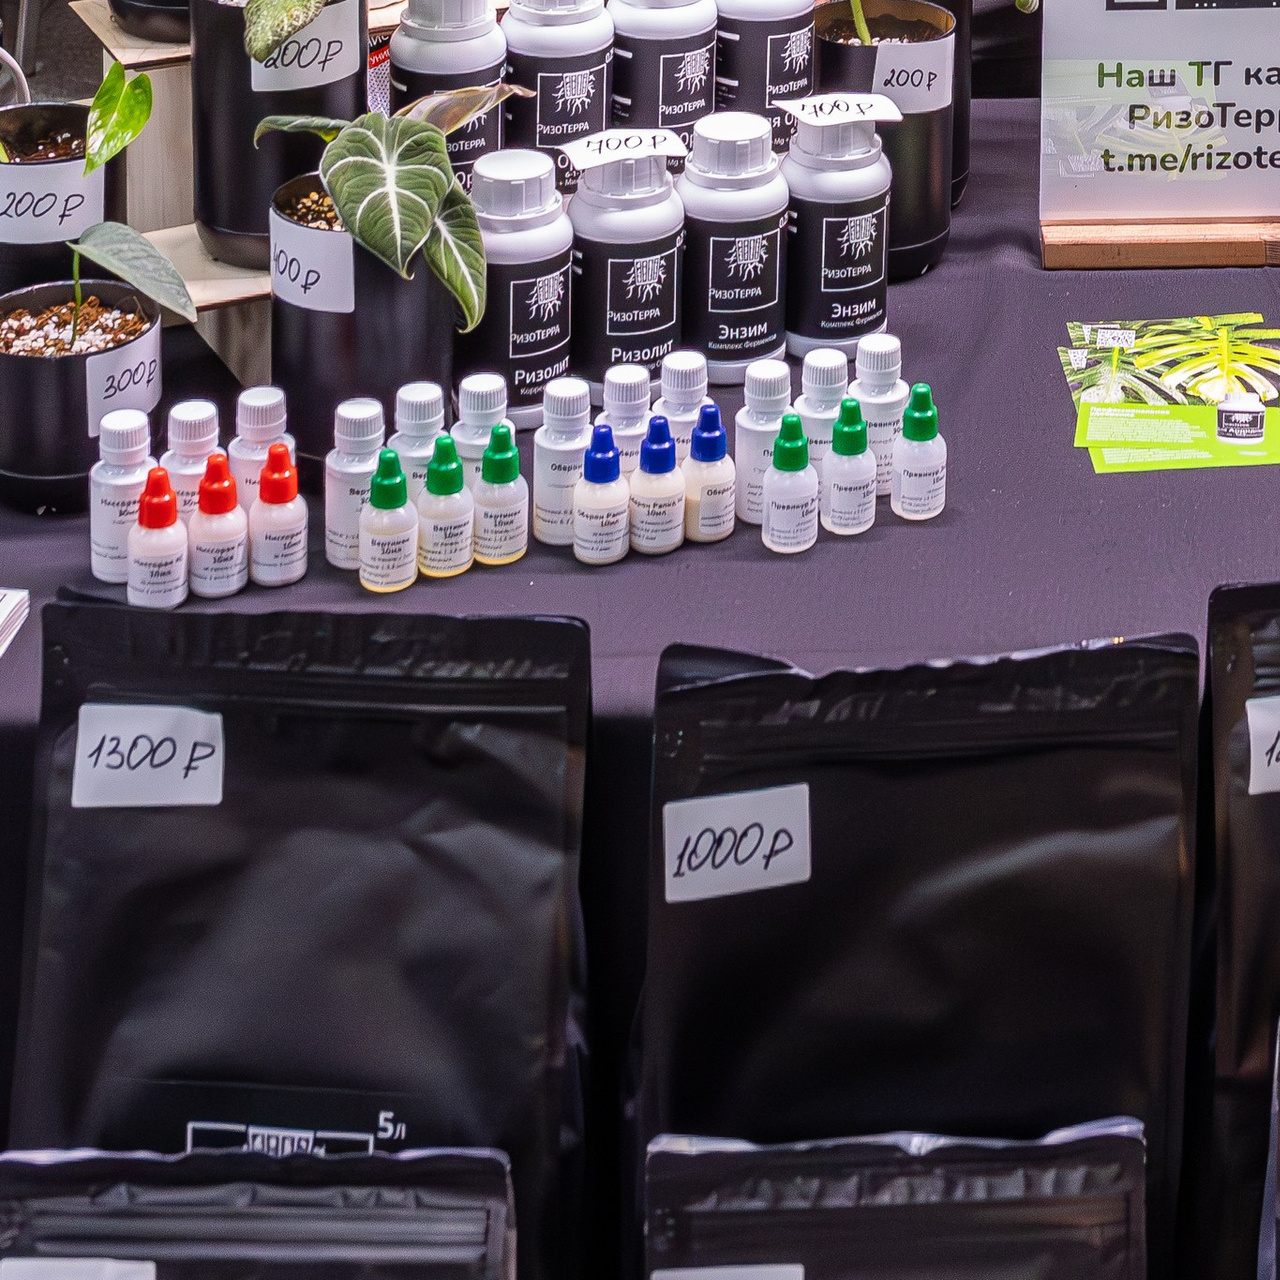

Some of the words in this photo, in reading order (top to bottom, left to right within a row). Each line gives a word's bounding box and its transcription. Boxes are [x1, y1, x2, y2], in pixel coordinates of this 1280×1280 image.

[1097, 61, 1176, 89] Наш
[1187, 60, 1233, 87] ТГ
[831, 298, 876, 318] Энзим
[718, 321, 768, 340] Энзим
[611, 339, 674, 363] Ризолит
[514, 354, 570, 385] Ризолит
[376, 1109, 407, 1141] 5л
